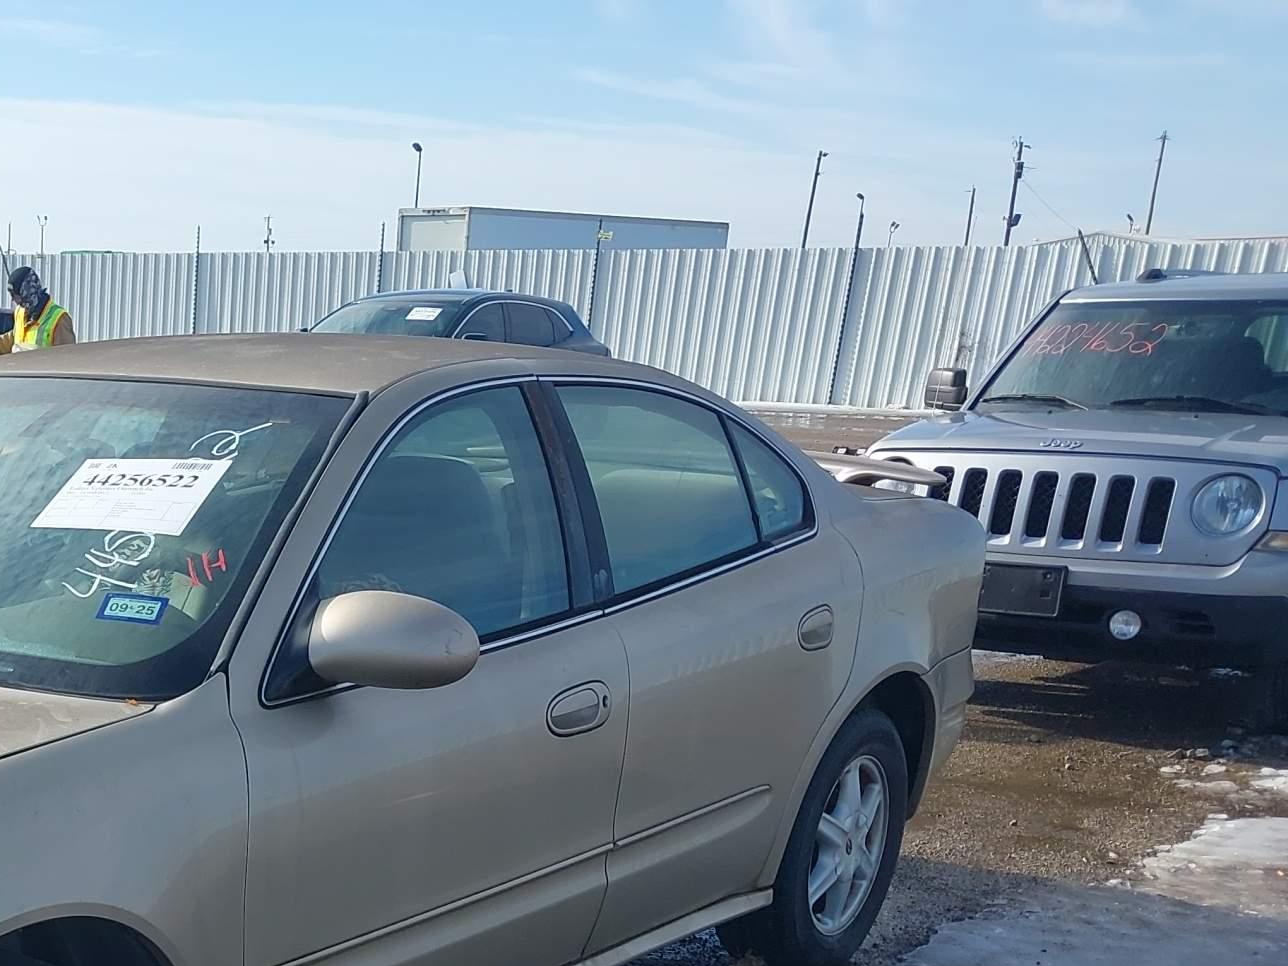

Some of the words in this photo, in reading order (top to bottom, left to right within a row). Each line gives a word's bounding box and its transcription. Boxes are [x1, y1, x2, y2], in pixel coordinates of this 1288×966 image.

[1040, 438, 1084, 449] Jeep
[83, 473, 200, 488] 44256522
[109, 602, 128, 612] 09
[136, 605, 156, 616] 25
